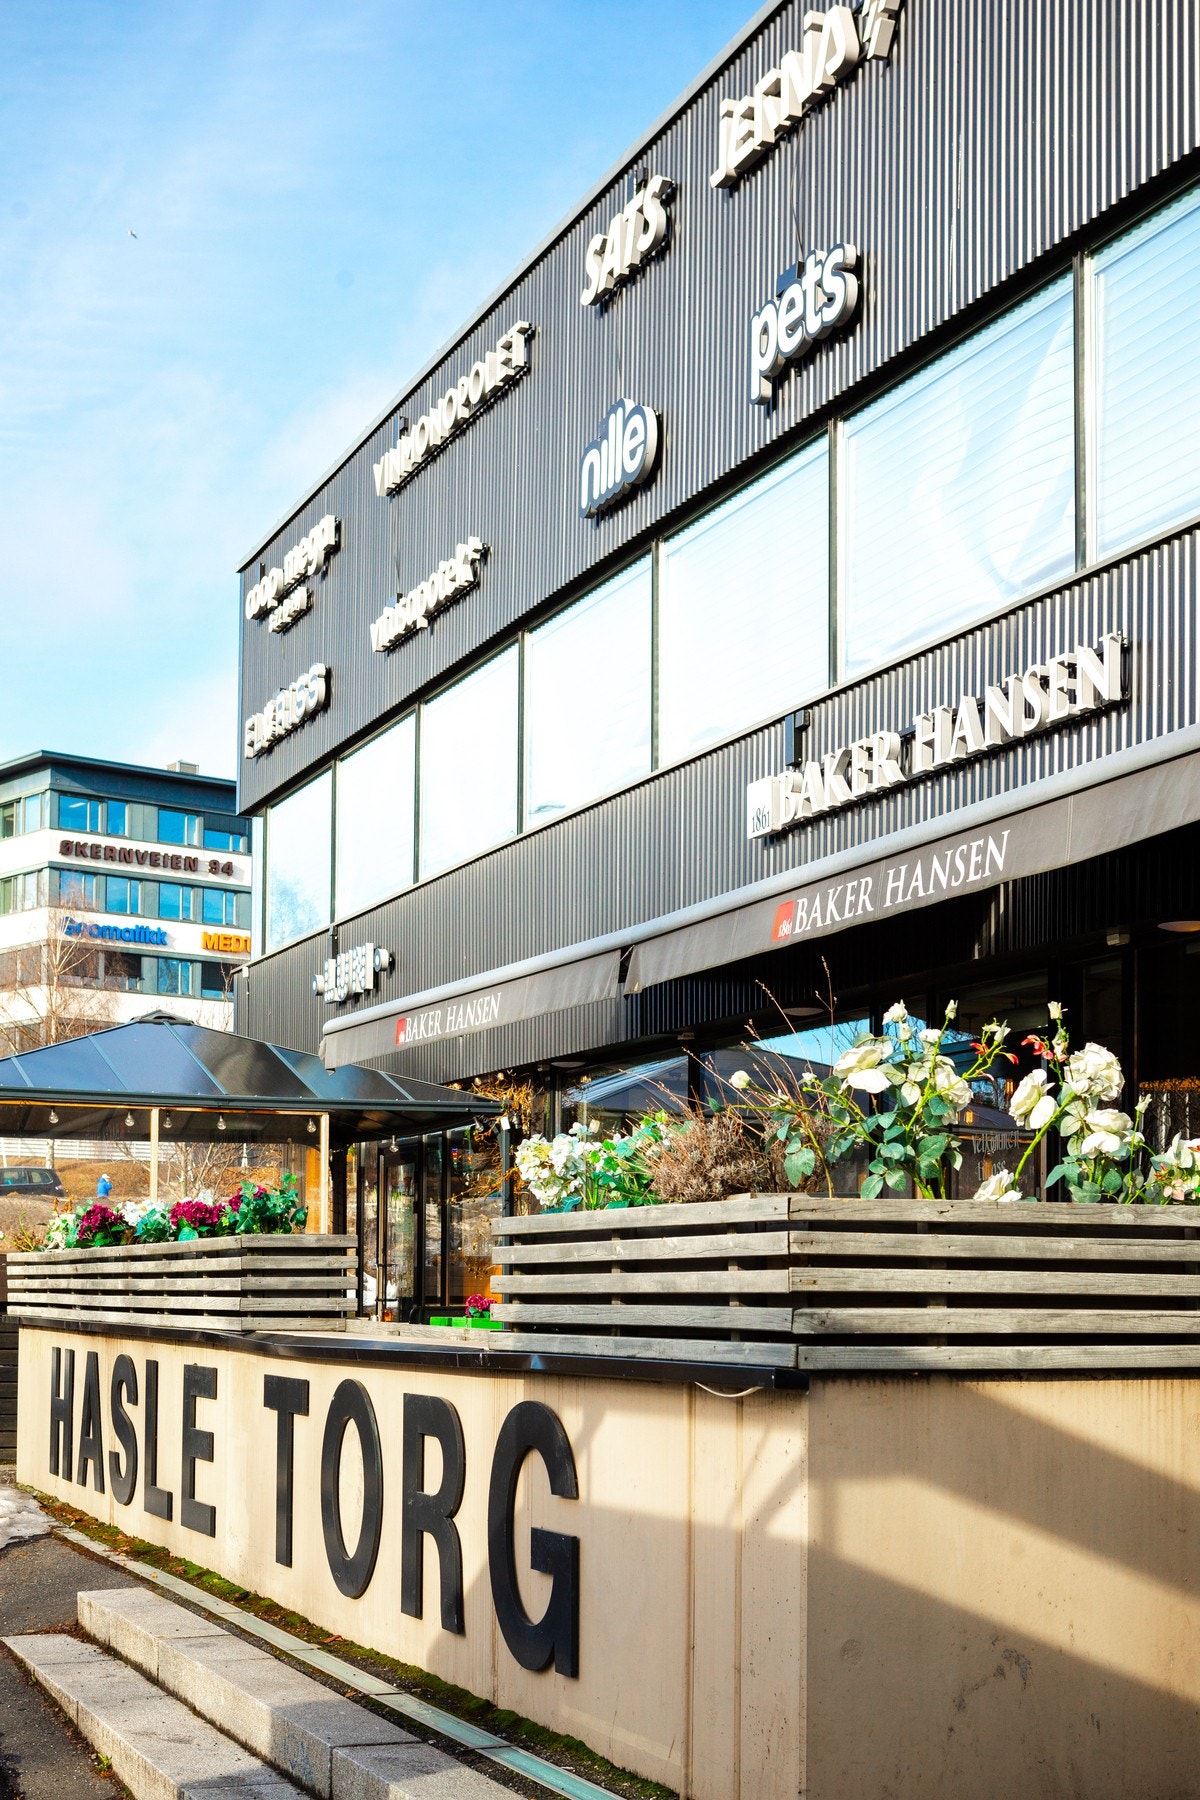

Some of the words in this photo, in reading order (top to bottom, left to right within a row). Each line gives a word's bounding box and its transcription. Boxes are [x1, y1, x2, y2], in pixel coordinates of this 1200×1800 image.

[580, 174, 676, 306] SATS
[750, 242, 860, 405] pets
[373, 320, 532, 497] VINMONOPOLET
[579, 401, 652, 514] nille
[776, 730, 907, 827] BAKER
[912, 632, 1125, 775] HANSEN
[59, 839, 199, 873] ØKERNVEIEN
[208, 859, 234, 877] 94
[751, 806, 771, 834] 1861
[793, 877, 874, 934] BAKER
[883, 829, 1011, 909] HANSEN
[405, 1009, 442, 1043] BAKER
[445, 991, 502, 1034] HANSEN
[49, 1346, 217, 1538] HASLE
[263, 1373, 579, 1679] TORG
